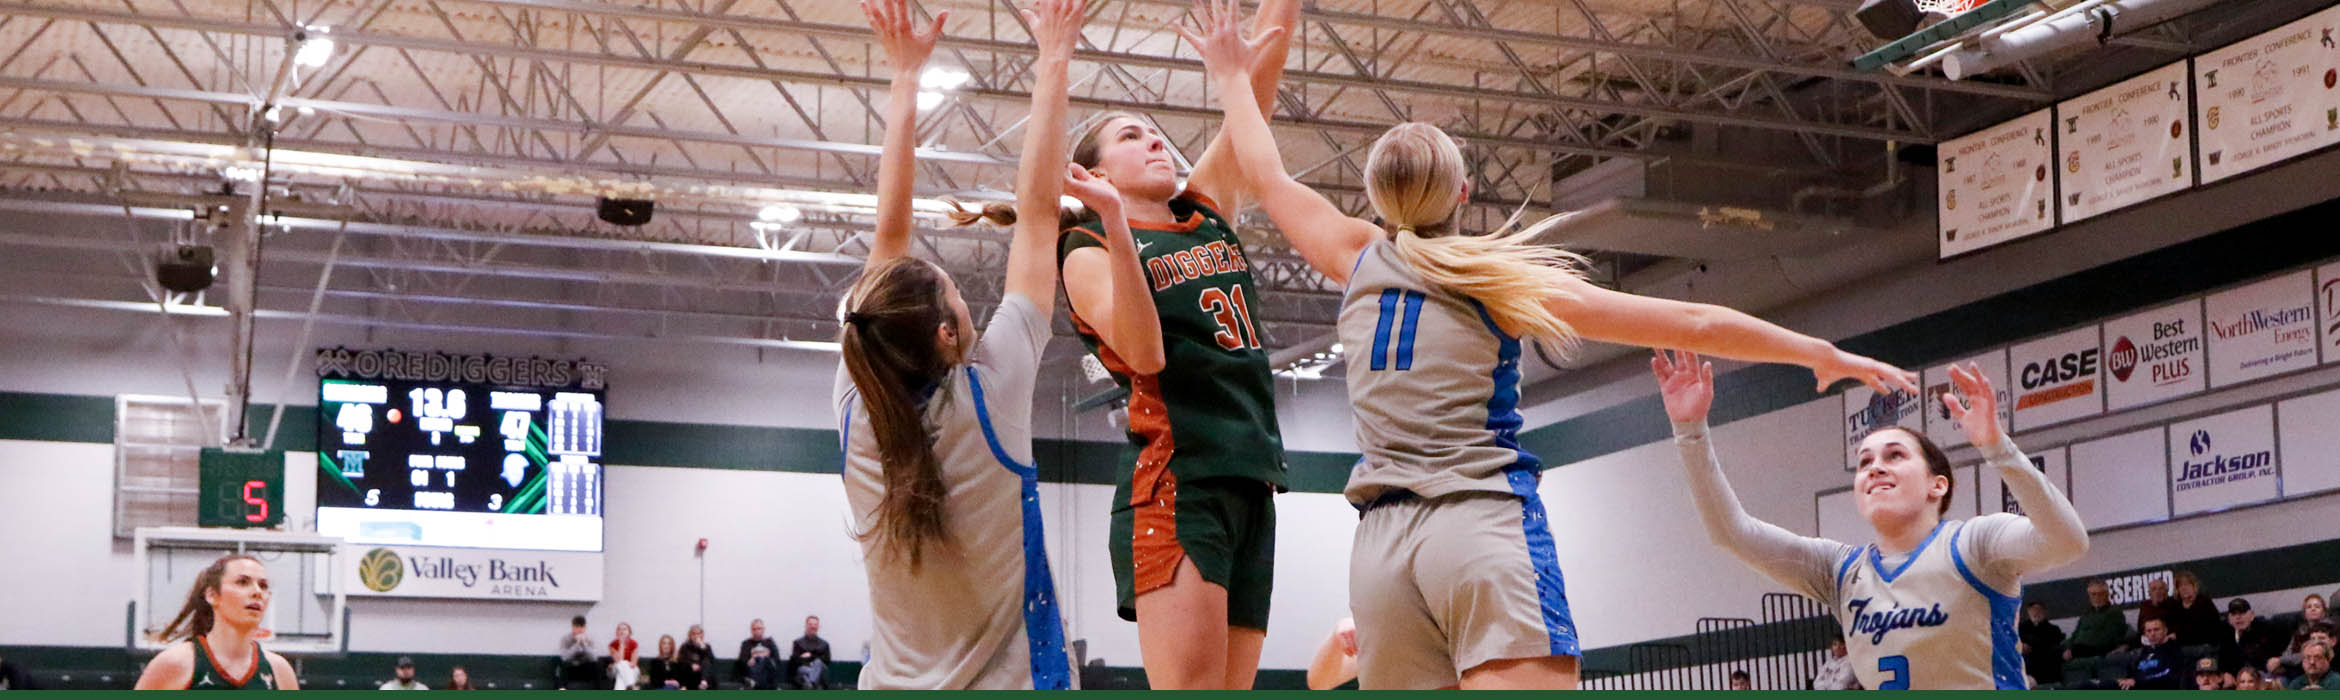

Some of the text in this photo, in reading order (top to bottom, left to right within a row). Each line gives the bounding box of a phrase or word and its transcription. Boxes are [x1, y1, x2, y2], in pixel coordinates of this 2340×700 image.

[1198, 284, 1261, 351] 31
[1370, 287, 1426, 371] 11
[2153, 318, 2184, 341] Best
[2211, 305, 2311, 340] NorthWestern
[2140, 336, 2199, 362] Western
[2274, 327, 2311, 344] Energy
[355, 350, 571, 387] OREDIGGERS
[2021, 347, 2099, 390] CASE
[2112, 348, 2135, 370] BW
[2152, 357, 2190, 383] PLUS
[2176, 450, 2270, 482] Jackson
[364, 488, 381, 506] 5
[2176, 475, 2226, 492] CONTRACTOR
[244, 480, 268, 522] 5
[487, 493, 503, 510] 3
[408, 556, 559, 588] Valley Bank
[491, 585, 548, 597] ARENA
[1848, 596, 1949, 645] Trojans
